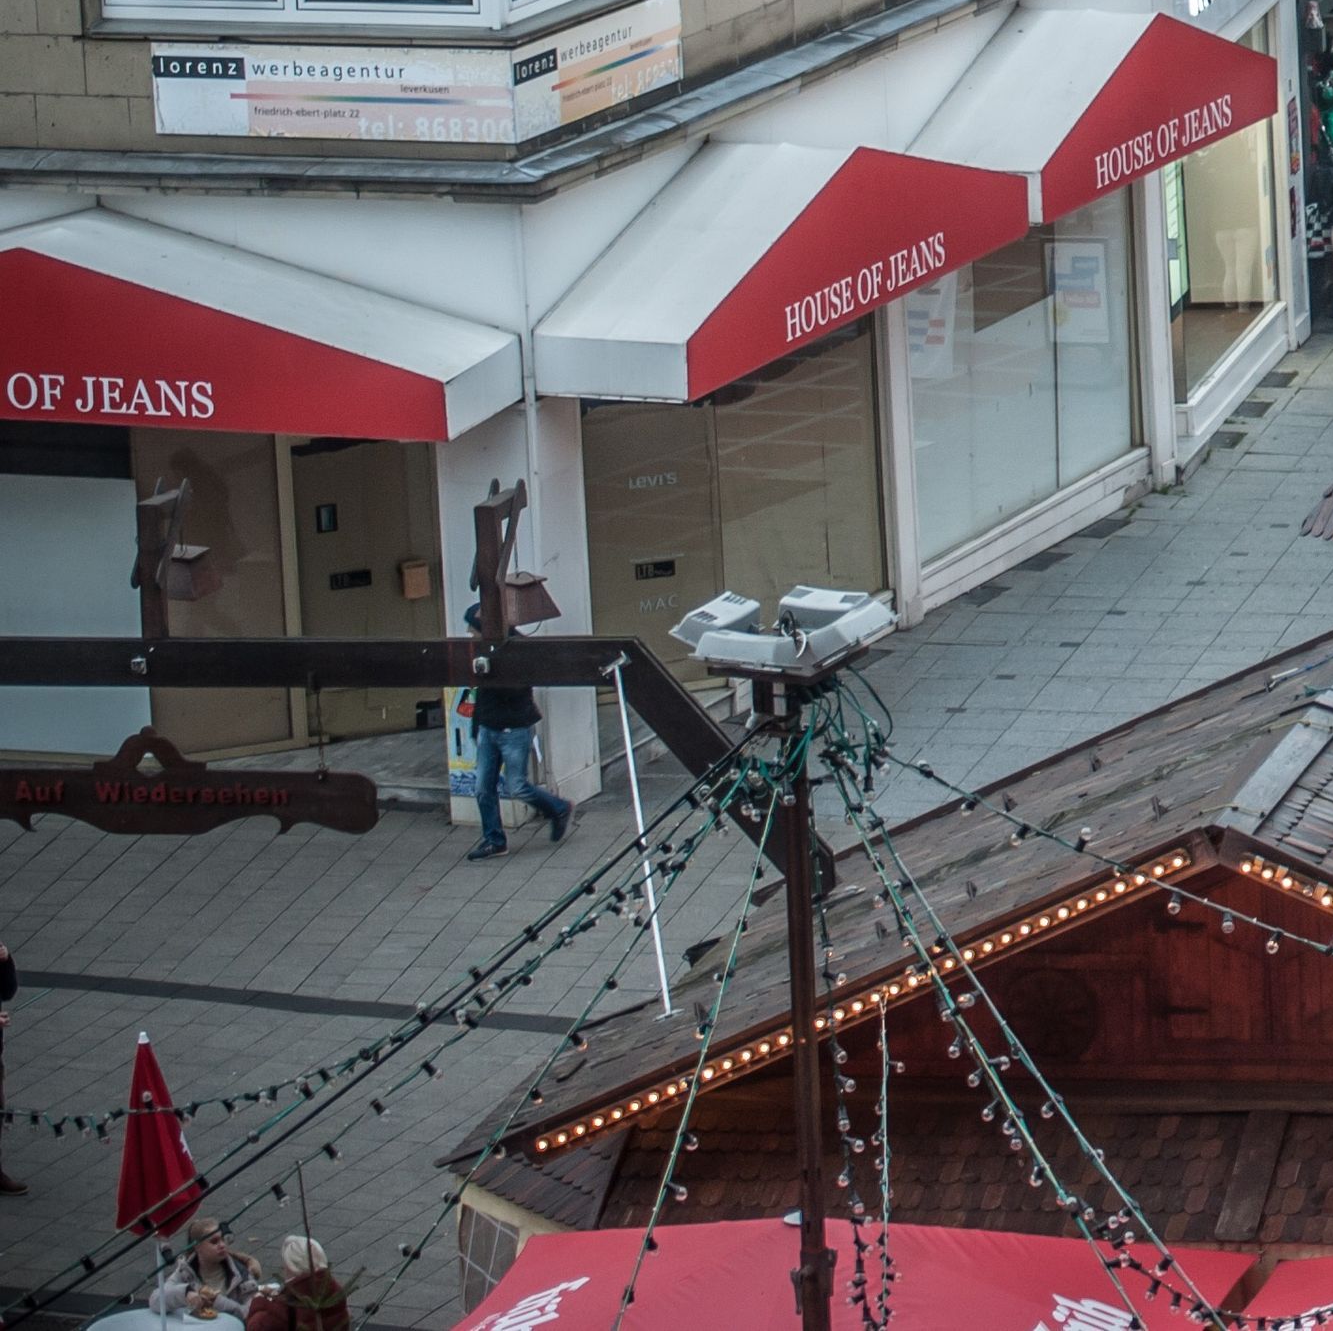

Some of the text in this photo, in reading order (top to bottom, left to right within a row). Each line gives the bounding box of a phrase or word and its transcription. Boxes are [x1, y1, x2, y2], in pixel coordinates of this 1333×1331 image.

[515, 53, 556, 80] lorenz
[560, 25, 634, 62] werbeagentur
[159, 57, 407, 82] lorenz werbeagentur
[400, 83, 451, 95] leverkusen
[254, 105, 361, 120] friedrich-ebert-platz 22
[1094, 93, 1233, 190] HOUSE OF JEANS
[784, 231, 947, 343] HOUSE OF JEANS
[7, 372, 215, 419] OF JEANS
[639, 594, 680, 613] MAC
[15, 780, 289, 805] Auf Wiedersehen
